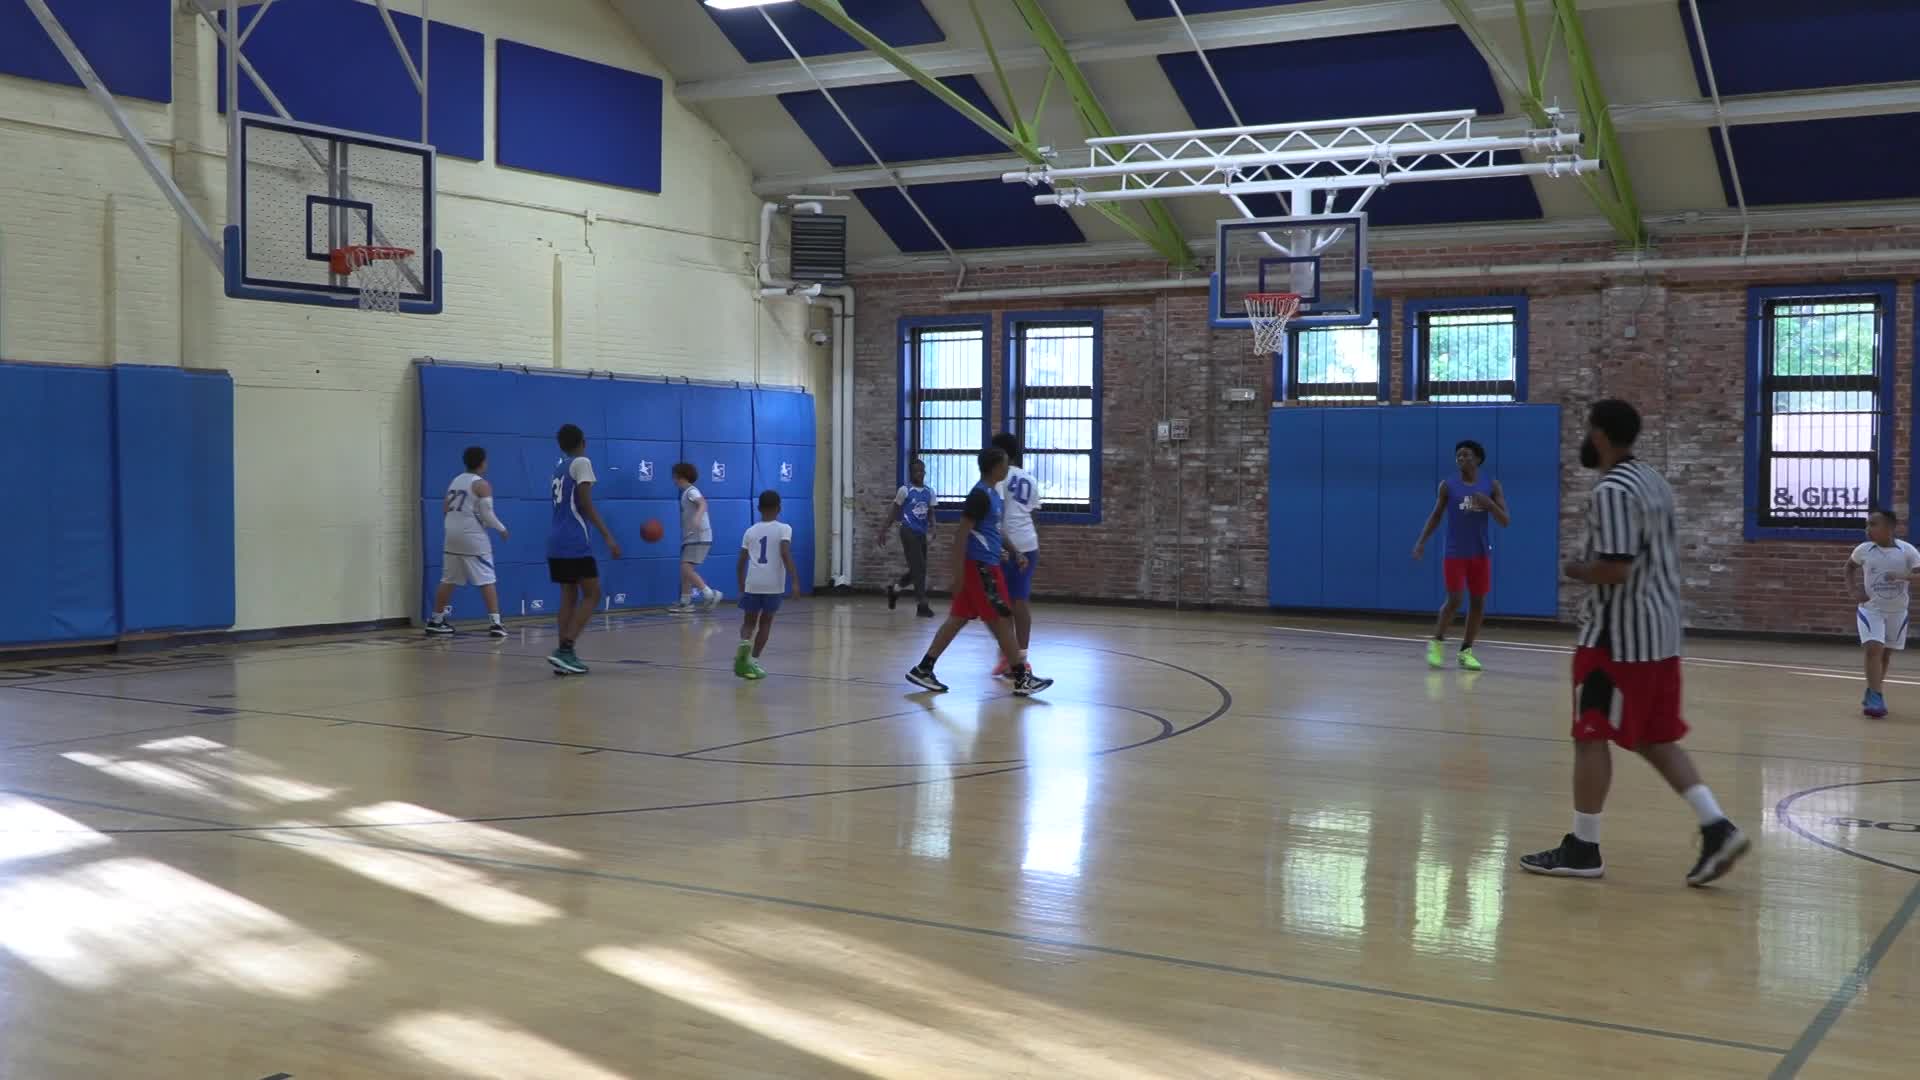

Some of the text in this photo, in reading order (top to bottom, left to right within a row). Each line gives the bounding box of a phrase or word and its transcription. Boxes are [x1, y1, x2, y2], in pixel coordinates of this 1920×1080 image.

[448, 489, 468, 512] 27
[1007, 475, 1031, 505] 40
[1773, 487, 1868, 506] & GIRL
[758, 535, 769, 565] 1
